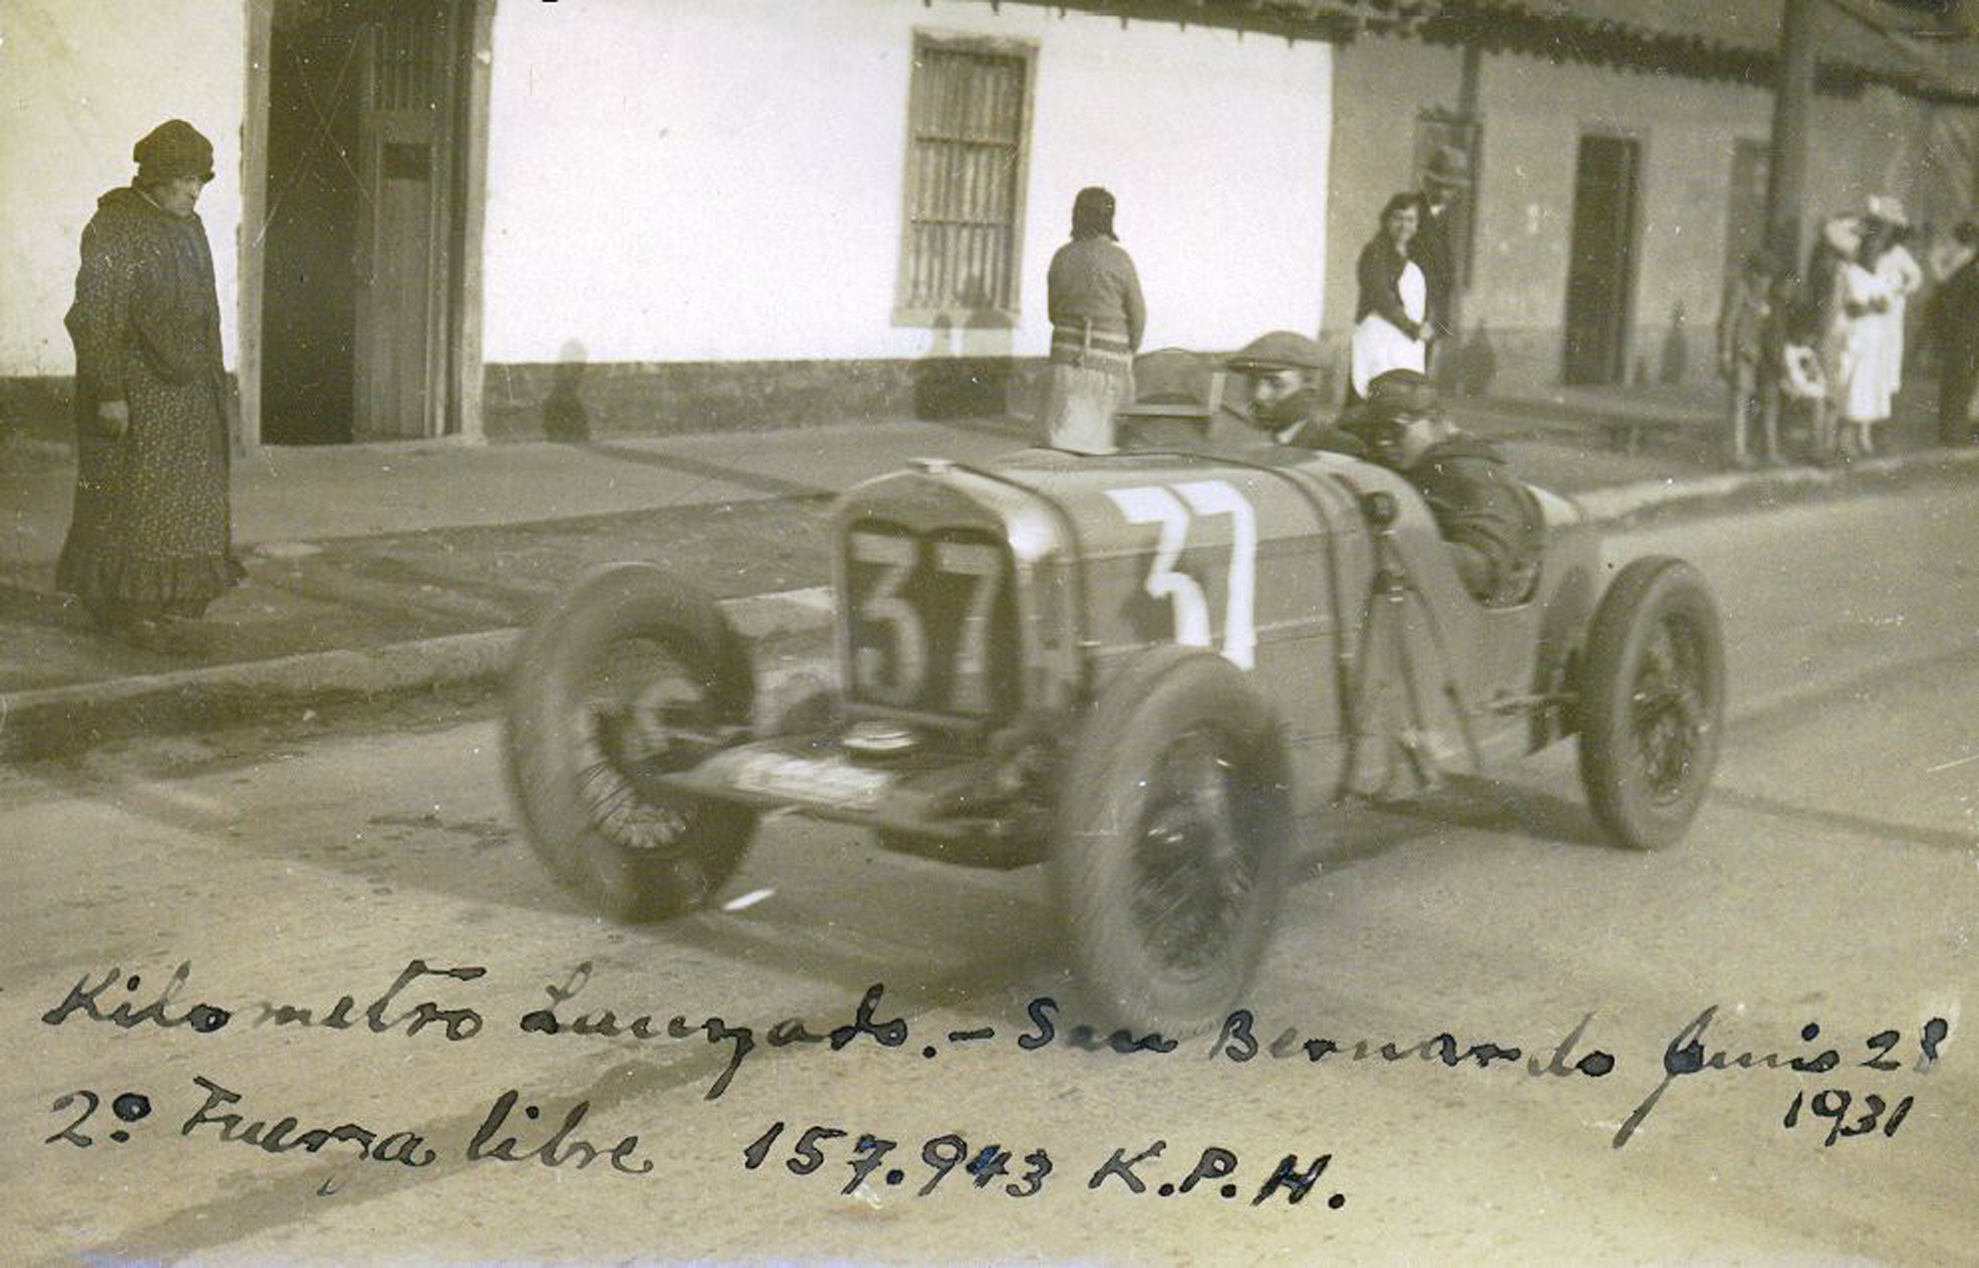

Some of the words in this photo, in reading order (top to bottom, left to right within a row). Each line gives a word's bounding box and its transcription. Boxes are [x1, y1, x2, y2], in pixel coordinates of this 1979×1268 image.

[1103, 479, 1257, 671] 37
[849, 530, 1000, 708] 37
[1209, 1008, 1615, 1077] Bernardo
[467, 1090, 655, 1174] libre
[1783, 1089, 1915, 1147] 1931
[744, 1121, 1054, 1197] 157.943
